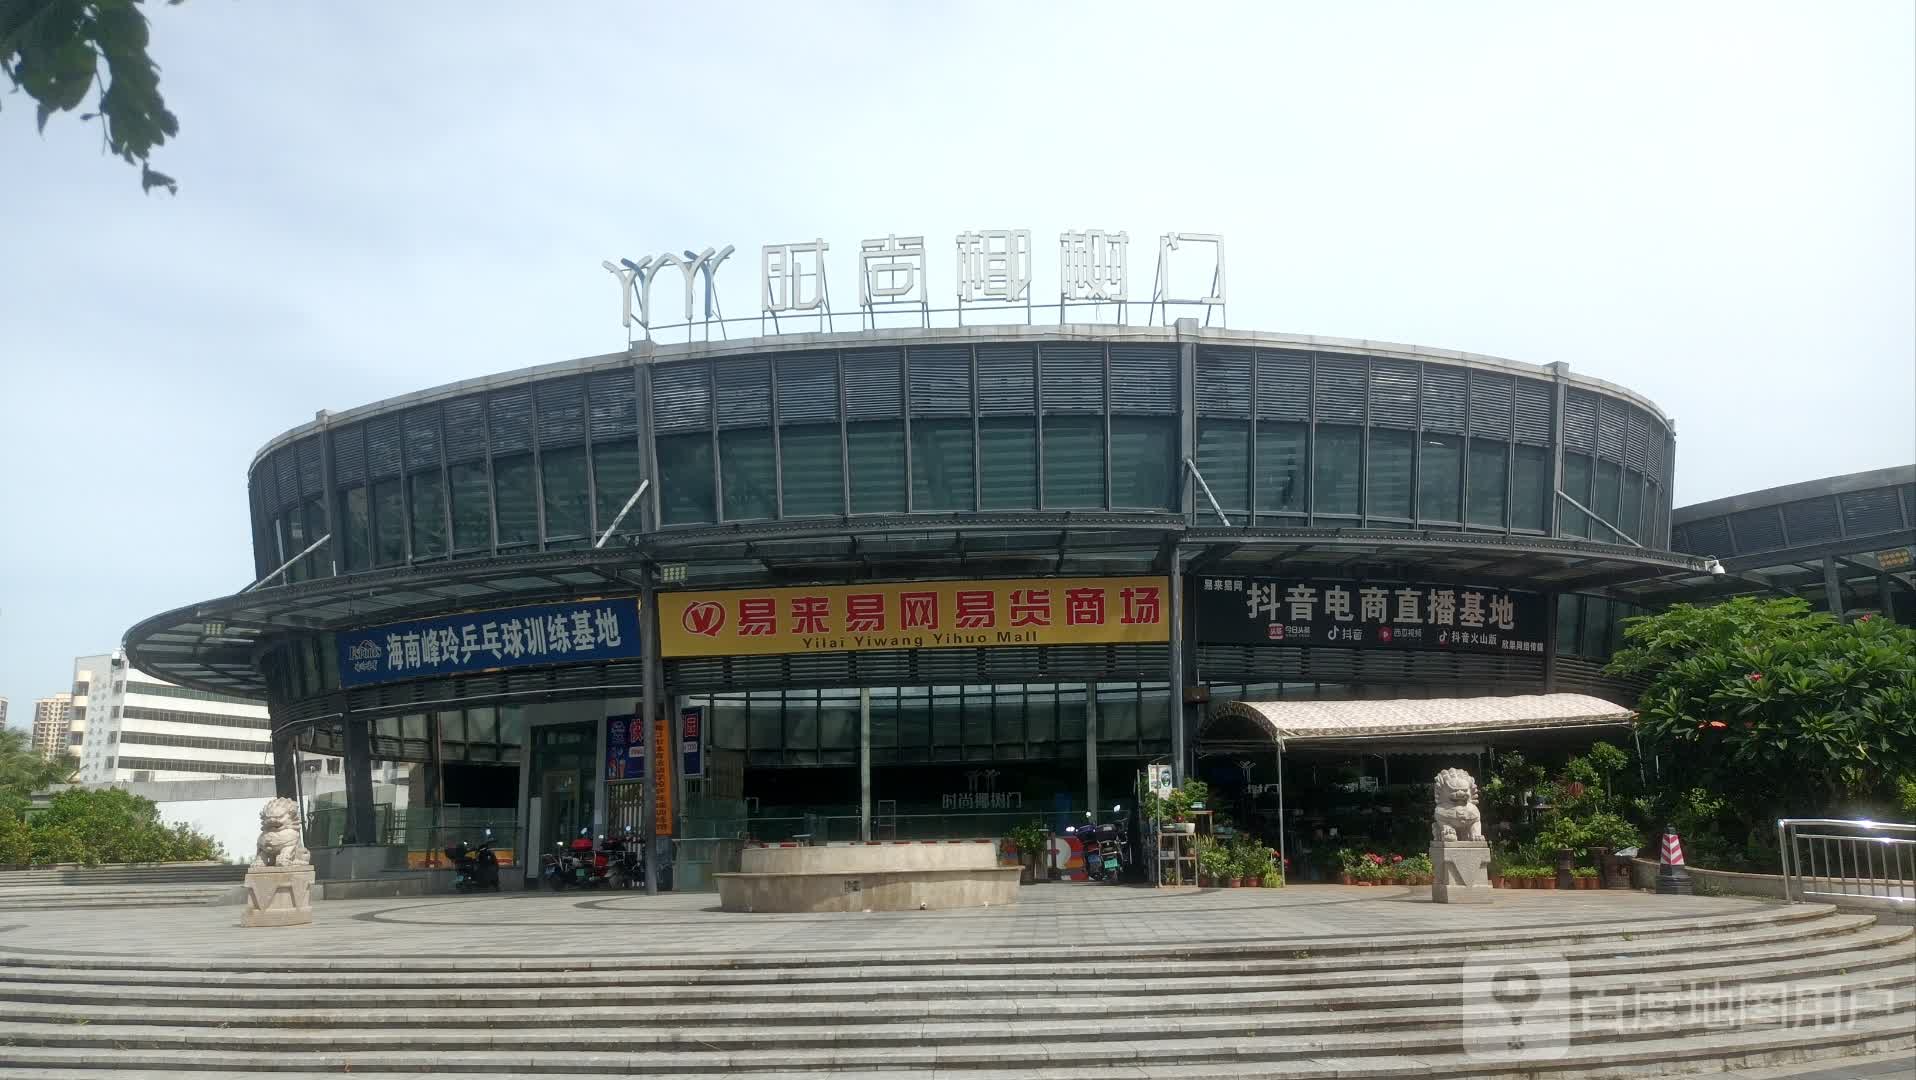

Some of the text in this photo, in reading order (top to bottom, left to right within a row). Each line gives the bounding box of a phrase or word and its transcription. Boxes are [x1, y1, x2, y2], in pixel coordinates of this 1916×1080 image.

[736, 587, 1161, 636] 易来易网易货商场
[1246, 582, 1514, 630] 抖音电商直播基地
[386, 607, 621, 670] 海南峰玲乒乓球训练基地
[1285, 626, 1311, 634] 今日头条
[1342, 629, 1363, 641] 抖音
[1393, 628, 1422, 638] 西瓜视频
[1451, 631, 1497, 645] 抖音火山版
[801, 629, 1038, 649] Yilai Yiwang Yihuo Mall
